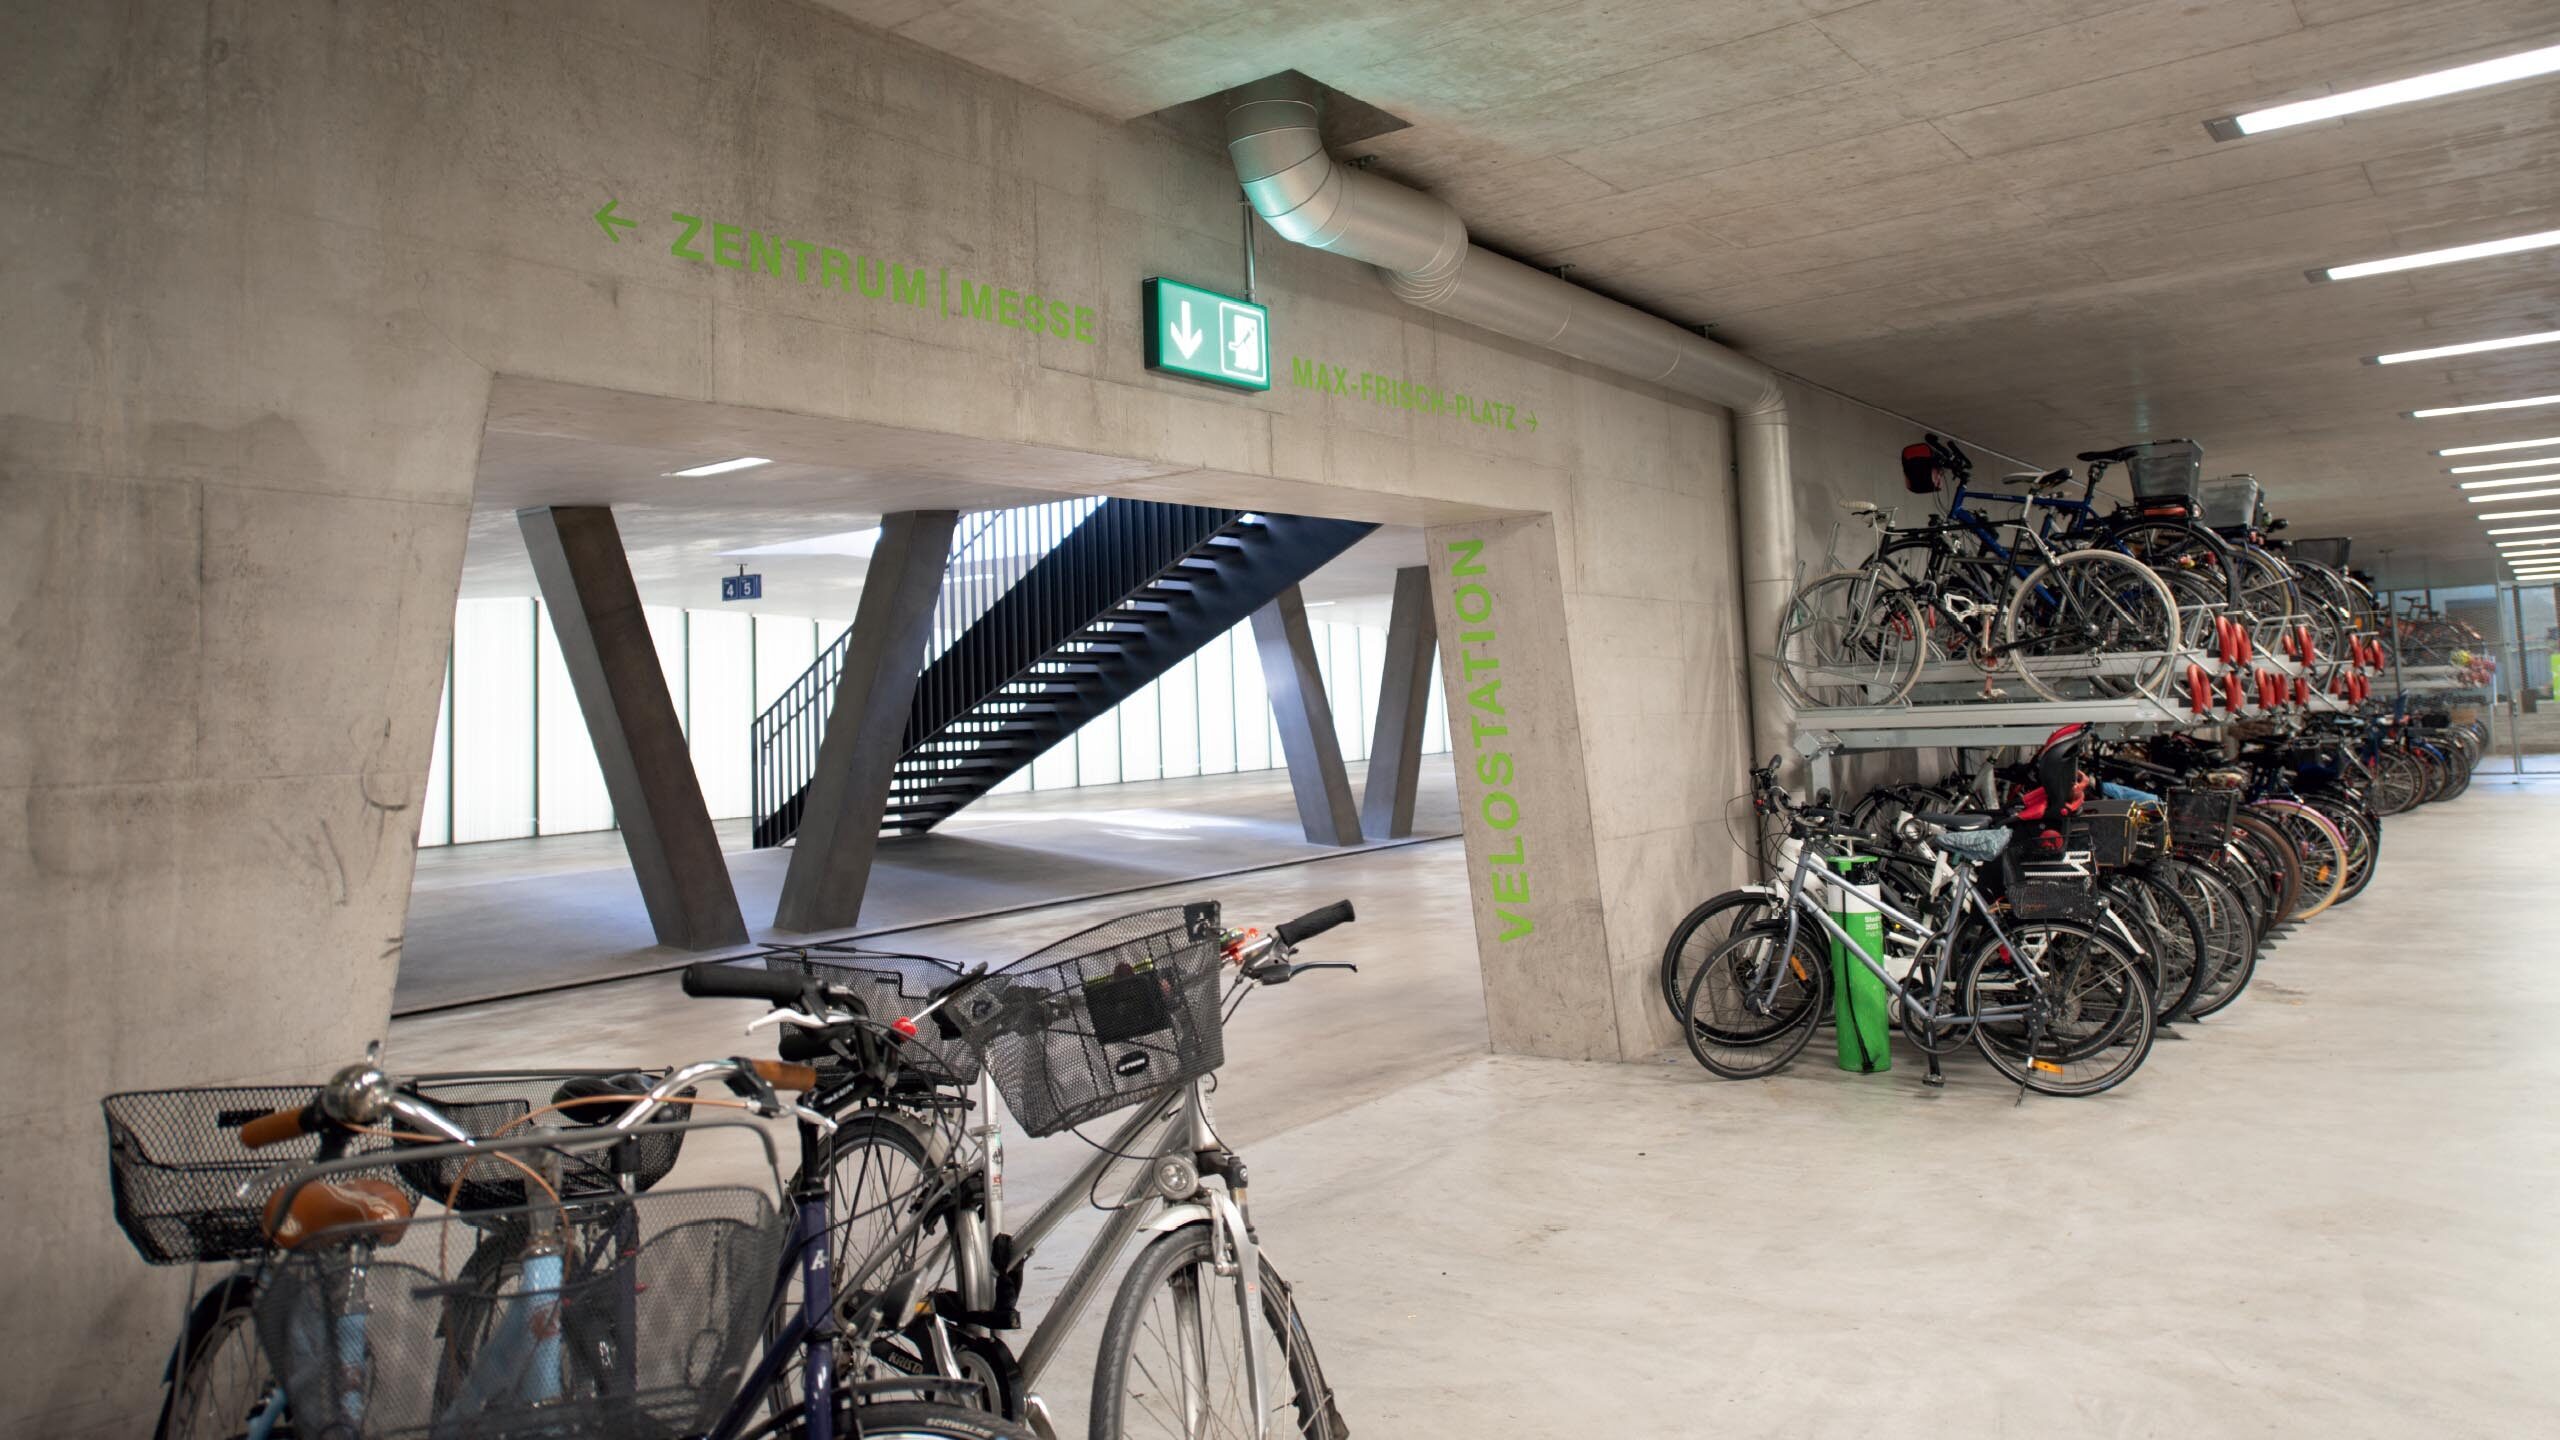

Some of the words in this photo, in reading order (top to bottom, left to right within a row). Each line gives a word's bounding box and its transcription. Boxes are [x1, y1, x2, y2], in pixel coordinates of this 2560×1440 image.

[671, 212, 926, 309] ZENTRUM
[961, 280, 1096, 345] MESSE
[1291, 356, 1517, 431] MAX-FRISCH-PLATZ
[726, 584, 734, 597] 4
[744, 582, 751, 595] 5
[1448, 538, 1534, 943] VELOSTATION
